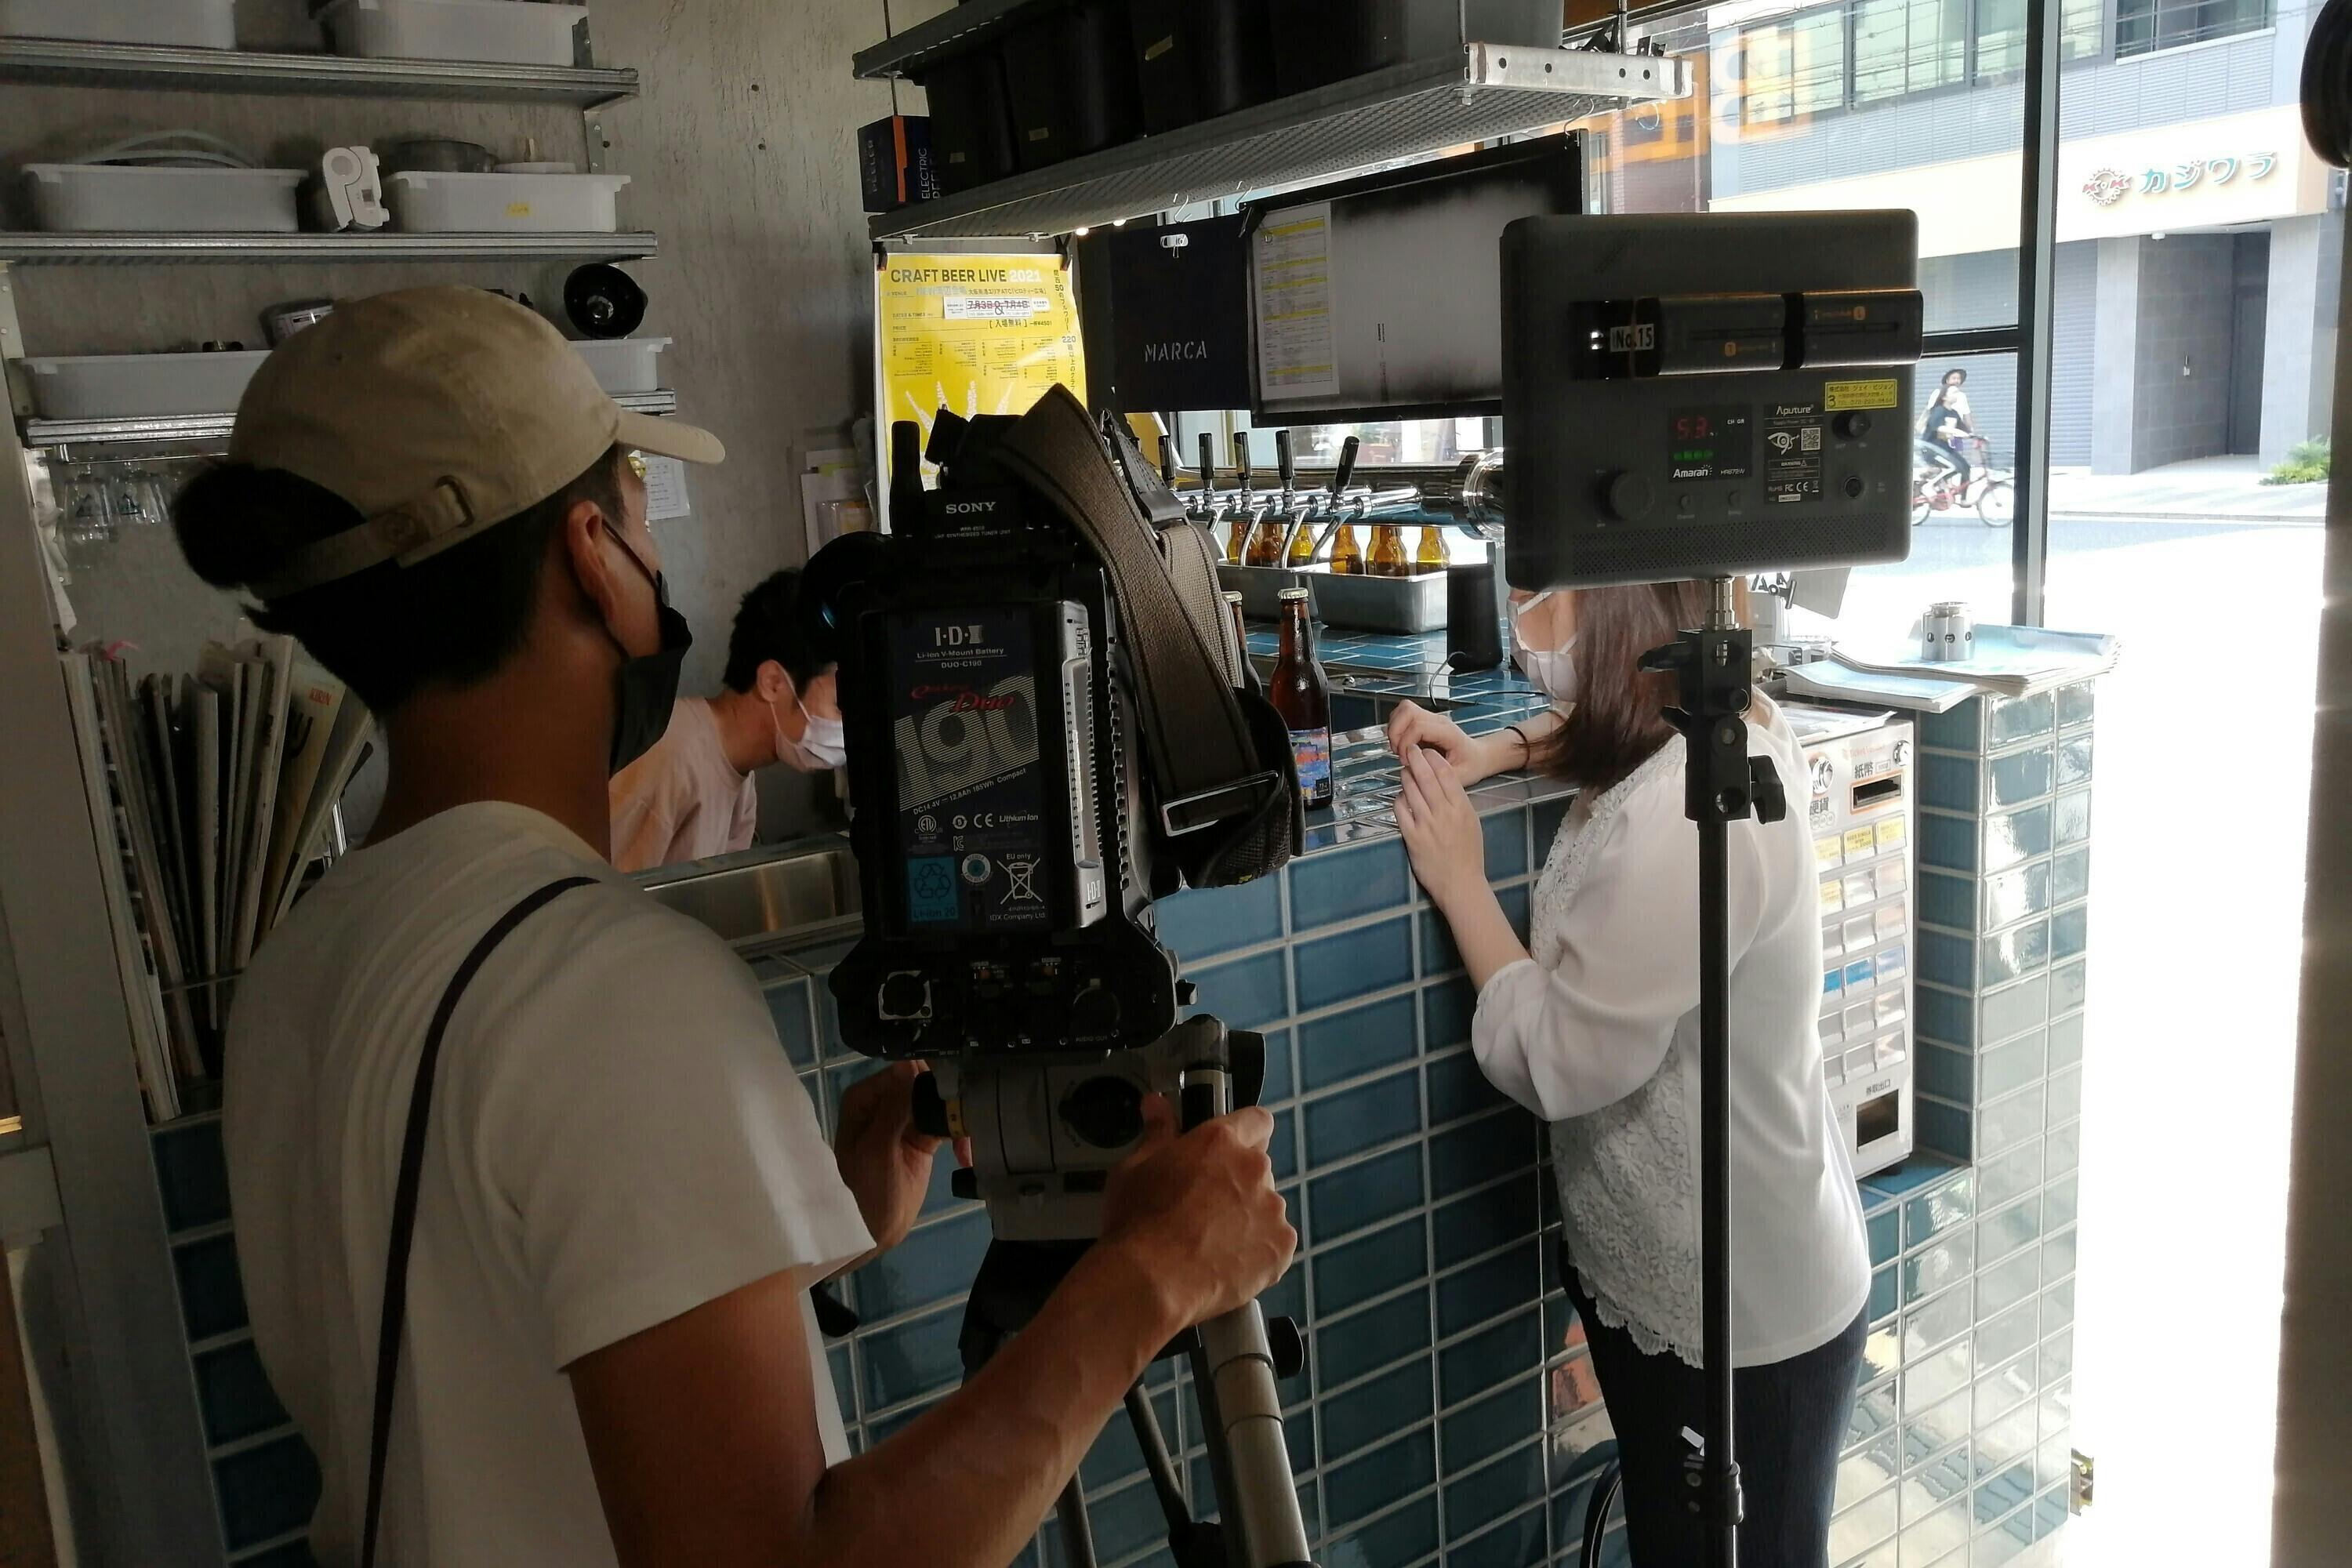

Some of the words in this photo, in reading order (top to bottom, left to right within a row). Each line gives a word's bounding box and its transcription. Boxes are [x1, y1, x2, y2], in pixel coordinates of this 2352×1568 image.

[918, 147, 931, 199] ELECTRIC
[2139, 151, 2278, 194] カジワラ
[891, 269, 938, 283] CRAFT
[942, 269, 978, 283] BEER
[979, 269, 1007, 283] LIVE
[1009, 269, 1042, 283] 2021
[1617, 327, 1652, 348] No.15
[1145, 340, 1207, 362] MARCA
[1828, 394, 1836, 408] 3
[1672, 468, 1709, 478] Amaran
[946, 501, 996, 514] SONY
[942, 648, 974, 658] V-Mount
[975, 647, 1004, 656] Battery
[996, 768, 1026, 784] Compact
[1016, 852, 1032, 861] only
[1004, 913, 1033, 922] Company
